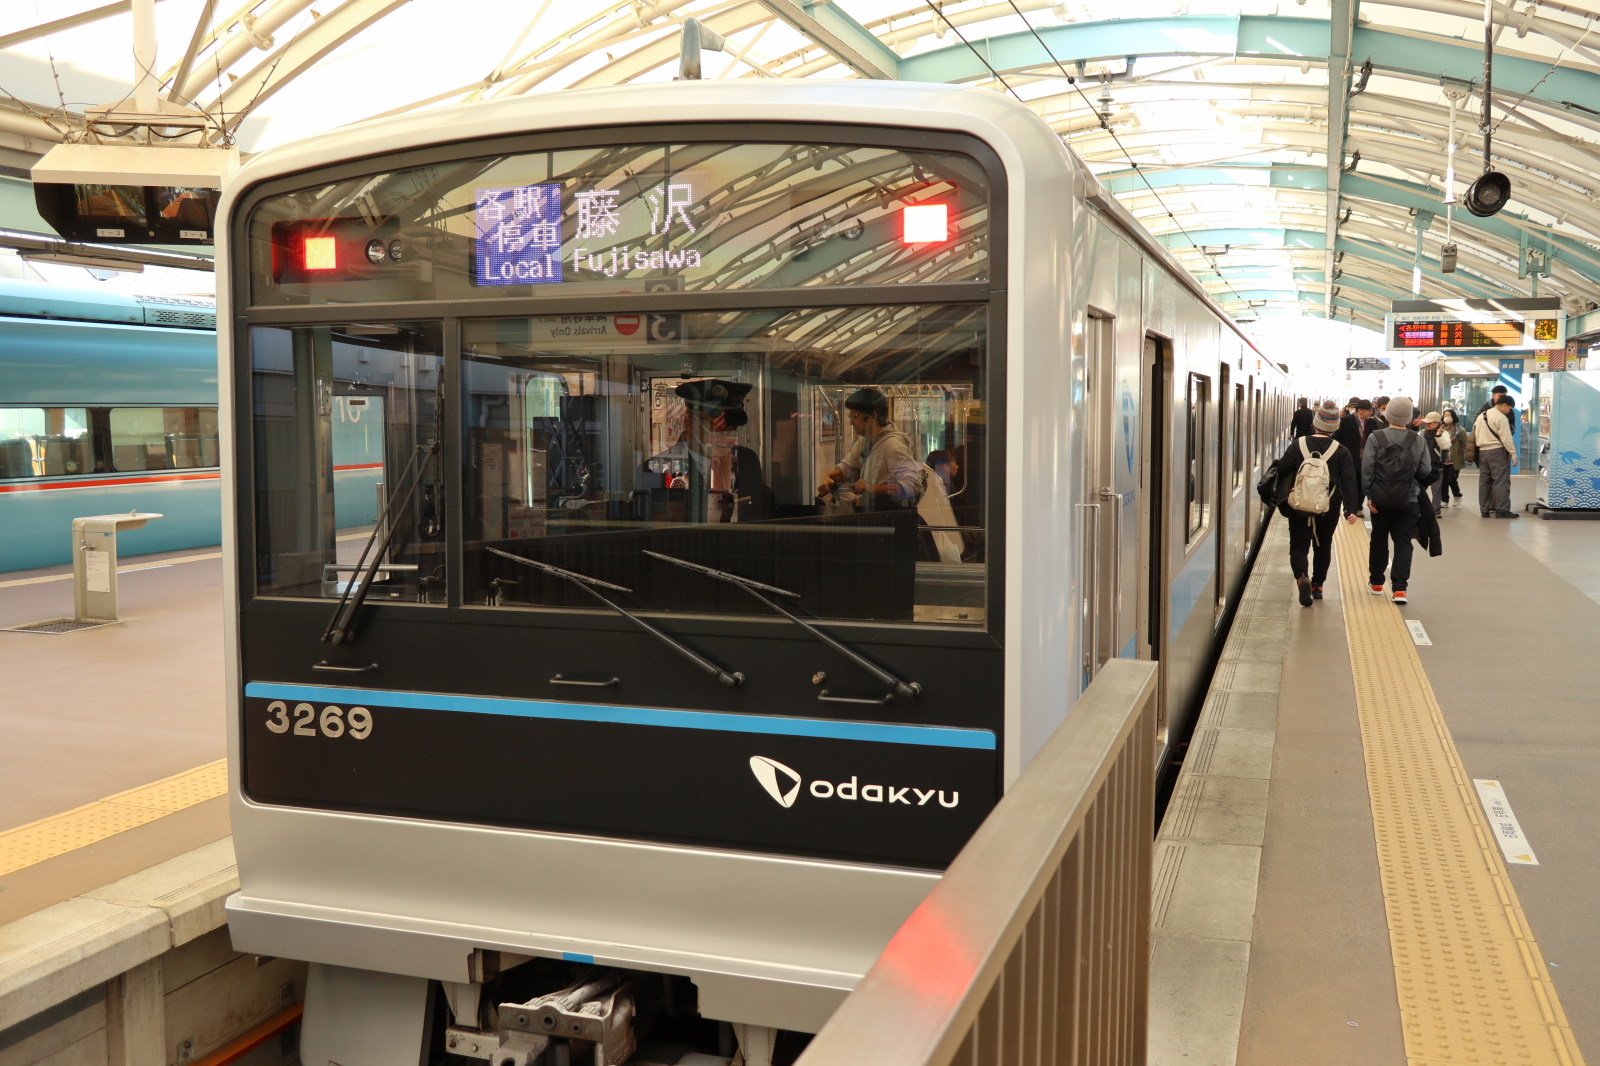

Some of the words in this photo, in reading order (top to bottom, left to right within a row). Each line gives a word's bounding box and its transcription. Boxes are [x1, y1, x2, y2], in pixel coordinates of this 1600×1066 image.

[574, 183, 697, 239] 藤沢
[487, 217, 561, 253] 停車
[484, 254, 554, 280] Local
[573, 246, 702, 278] Fujisawa
[1349, 358, 1358, 370] 2
[265, 700, 373, 740] 3269
[809, 775, 959, 808] odakyu
